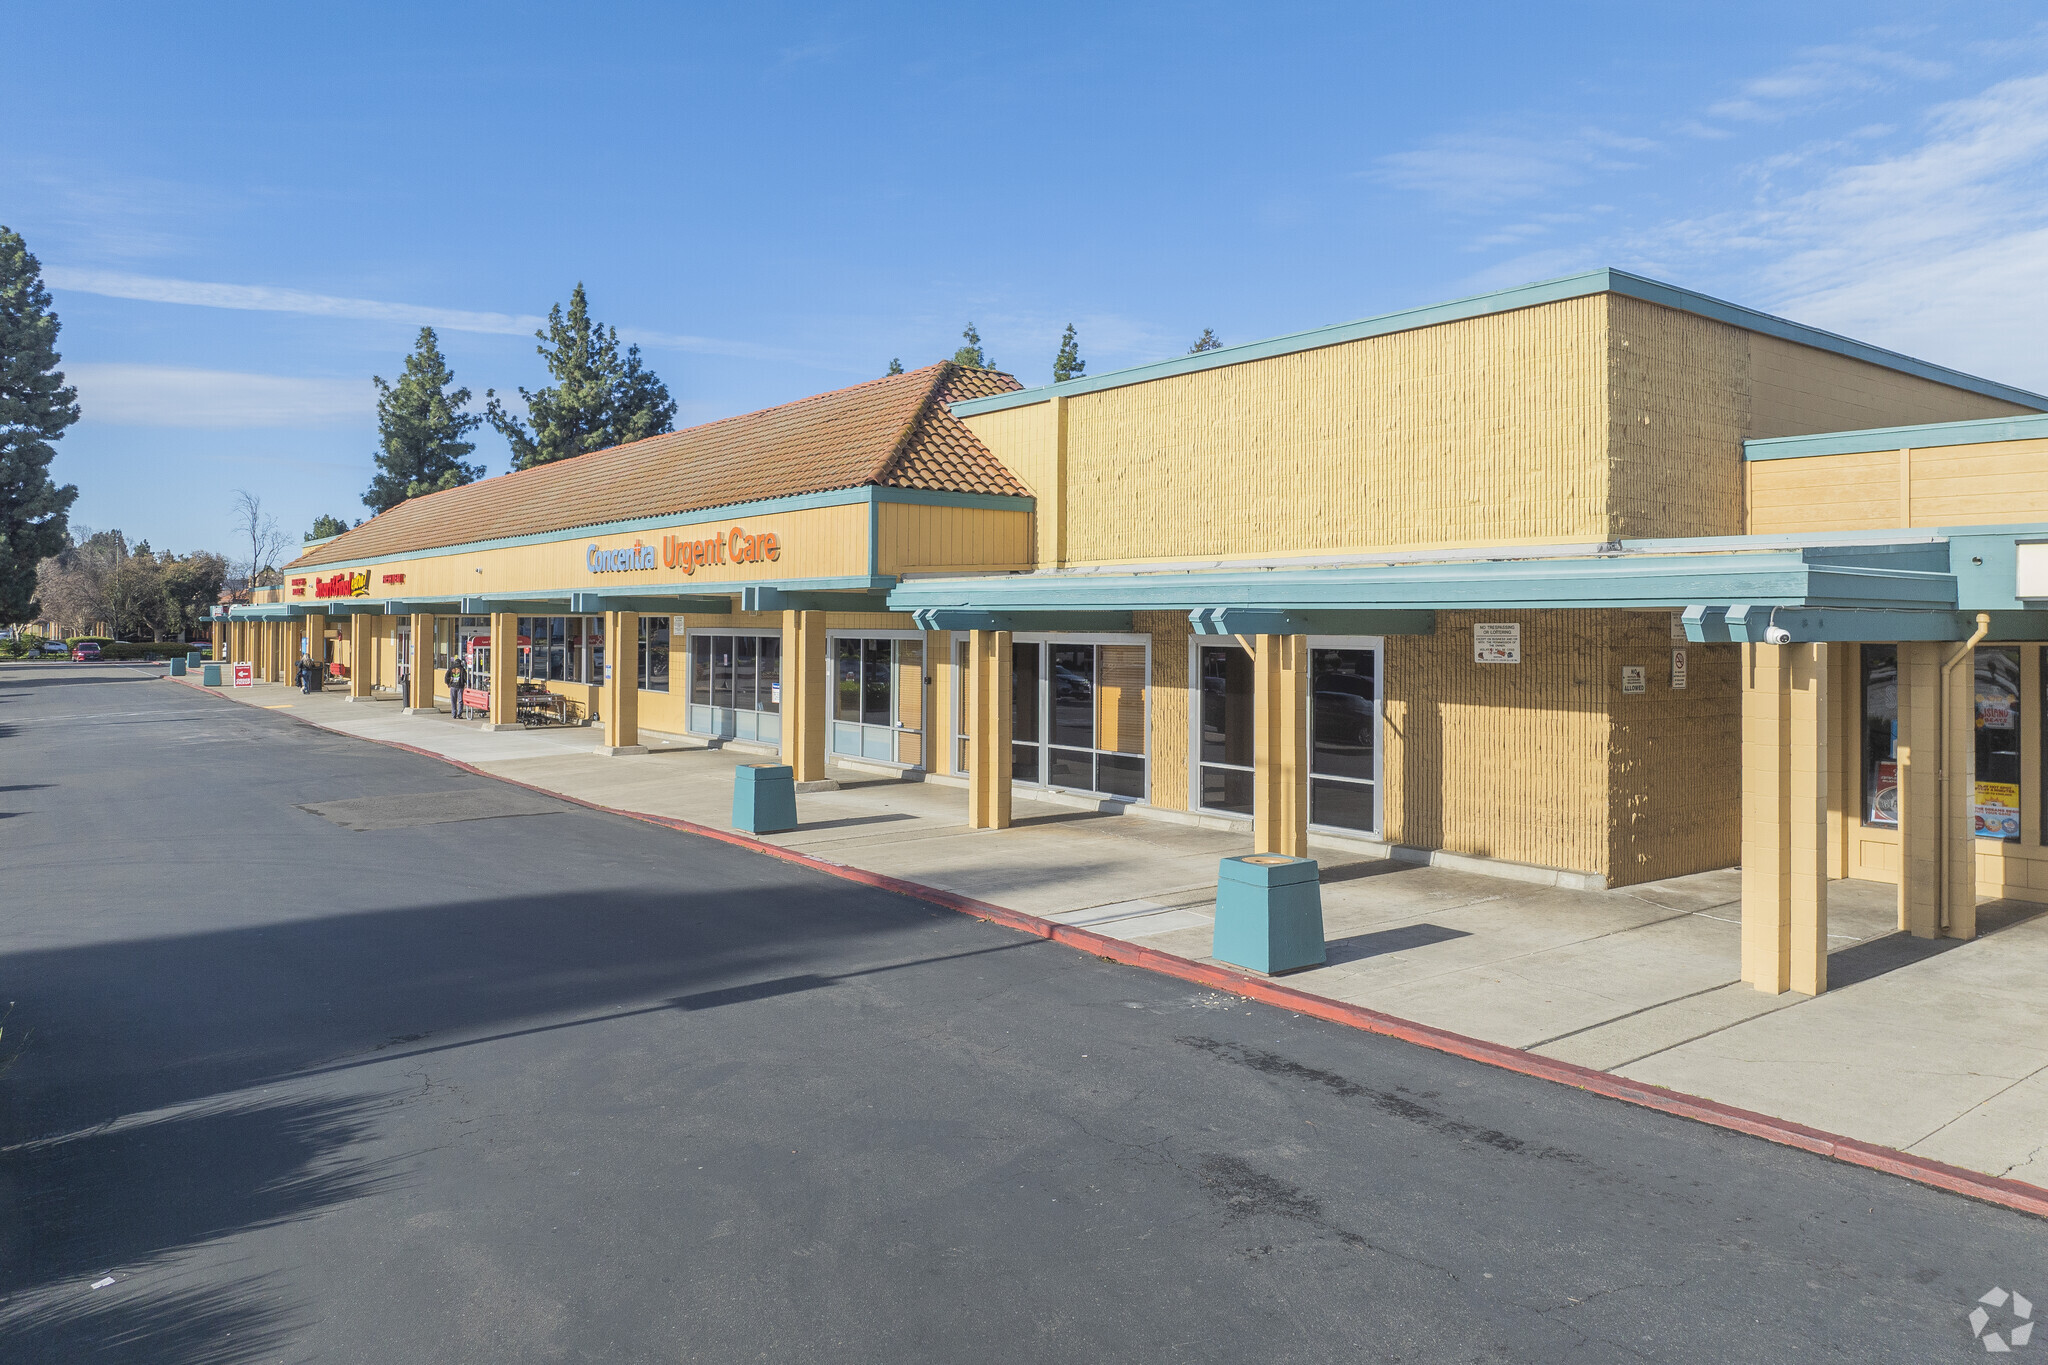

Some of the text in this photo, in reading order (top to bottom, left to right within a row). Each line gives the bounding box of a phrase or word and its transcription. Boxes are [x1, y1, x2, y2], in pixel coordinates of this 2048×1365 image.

[586, 526, 779, 575] Concentra Urgent Care
[1983, 708, 2009, 717] ISLAND
